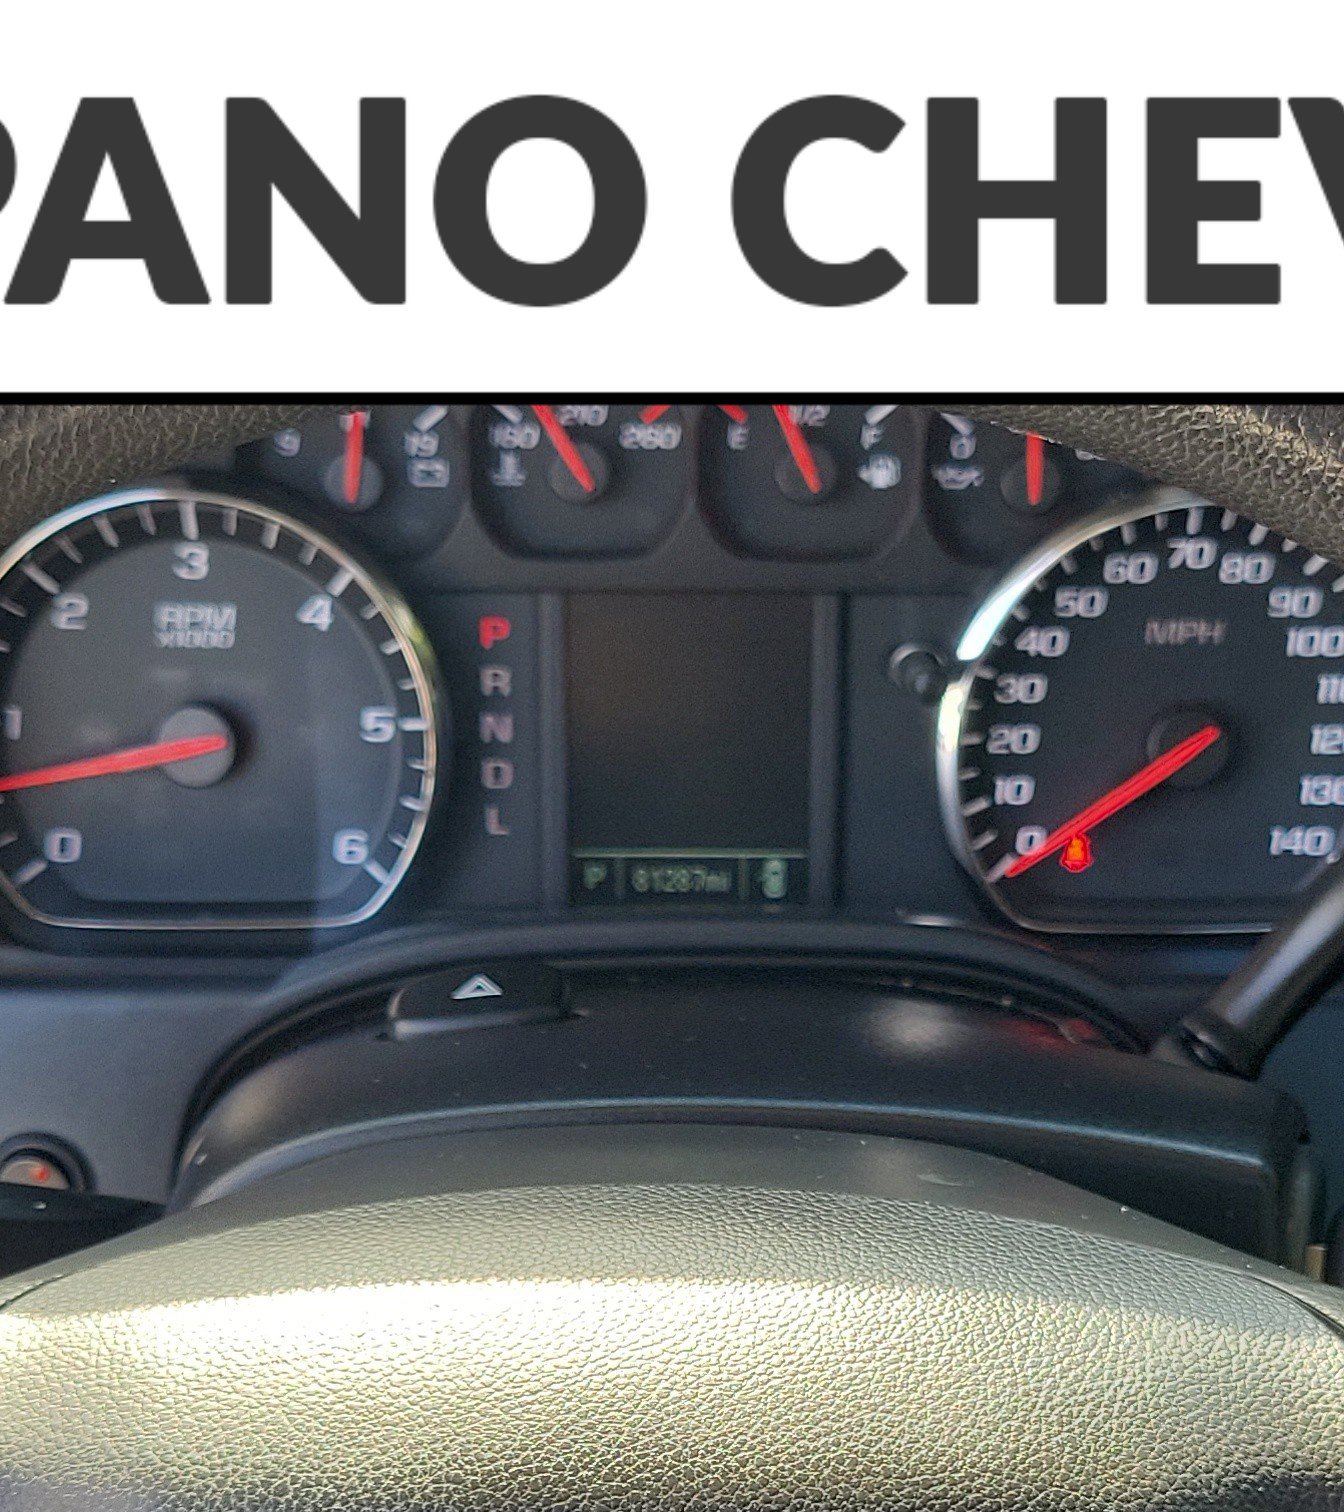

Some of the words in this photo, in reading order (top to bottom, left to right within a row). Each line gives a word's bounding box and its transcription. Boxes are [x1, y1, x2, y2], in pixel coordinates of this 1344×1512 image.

[172, 541, 210, 580] 3
[1103, 551, 1158, 586] 60
[1168, 537, 1217, 571] 70
[1218, 551, 1275, 586] 80
[55, 594, 89, 630] 2
[157, 603, 237, 631] RPM
[296, 599, 334, 631] 4
[1056, 587, 1109, 619] 50
[1267, 586, 1323, 620] 90
[479, 616, 511, 649] P
[1015, 625, 1070, 659] 40
[1144, 619, 1228, 646] MPH
[480, 667, 512, 697] R
[994, 674, 1048, 706] 30
[3, 705, 23, 740] 1
[360, 706, 396, 742] 5
[480, 713, 513, 743] N
[986, 723, 1041, 757] 20
[994, 774, 1036, 807] 10
[485, 805, 509, 836] L
[46, 829, 82, 864] 0
[333, 830, 368, 865] 6
[1015, 825, 1048, 857] 0
[1269, 825, 1335, 858] 140
